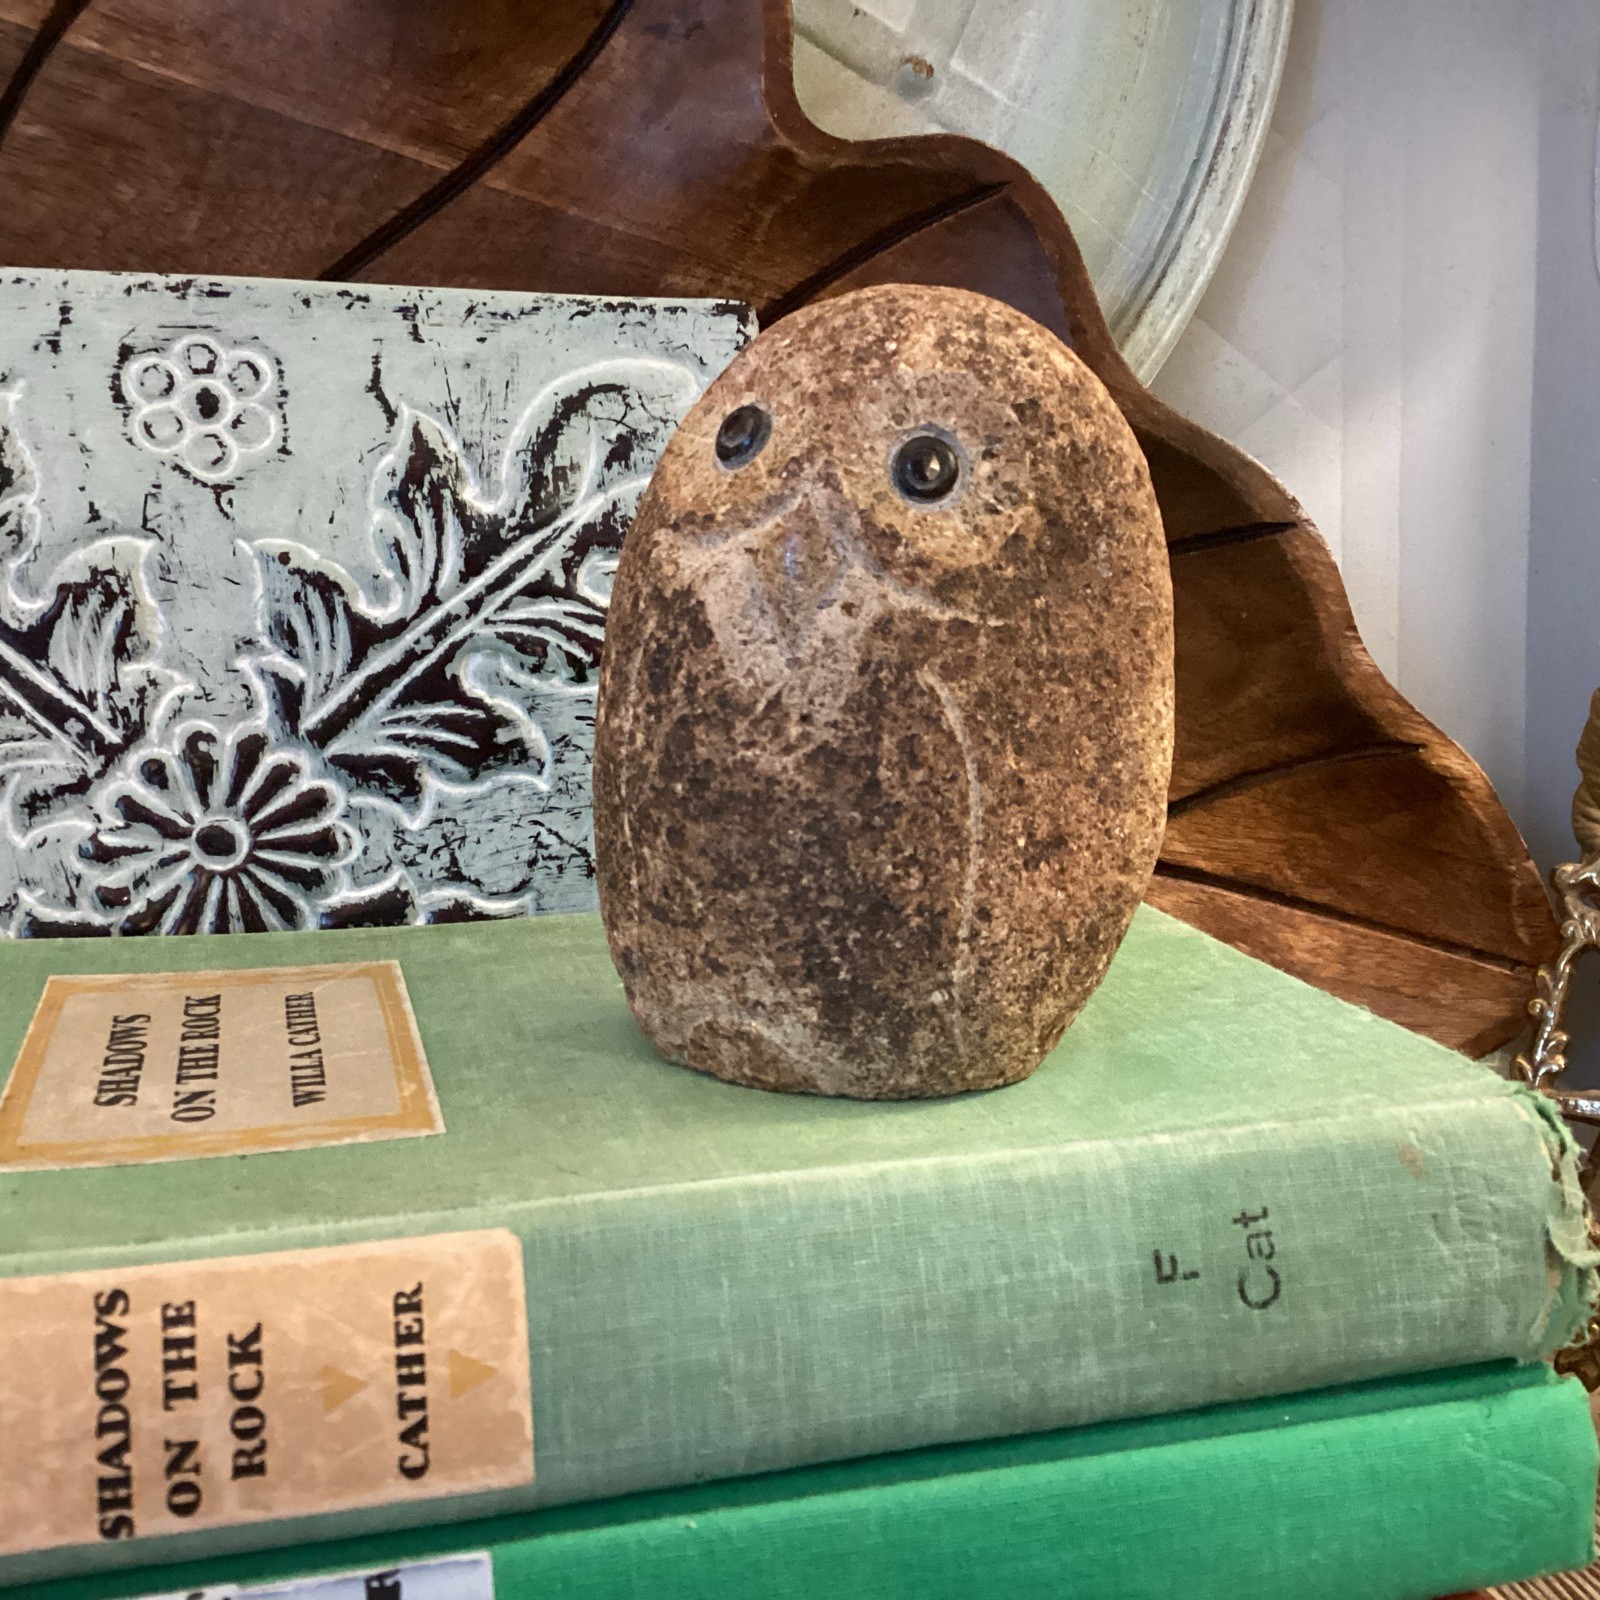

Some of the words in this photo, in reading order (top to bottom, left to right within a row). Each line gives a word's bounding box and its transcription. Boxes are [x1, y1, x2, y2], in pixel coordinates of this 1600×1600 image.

[181, 994, 221, 1041] ROCK
[285, 991, 322, 1047] CATHER
[94, 1014, 151, 1107] SHADOWS
[176, 1042, 220, 1085] THE
[290, 1048, 326, 1108] WILLA
[170, 1091, 216, 1123] ON
[1153, 1248, 1200, 1285] F
[1232, 1206, 1281, 1310] Cat
[161, 1300, 199, 1411] THE
[393, 1282, 431, 1480] CATHER
[94, 1288, 134, 1540] SHADOWS
[228, 1322, 267, 1481] ROCK
[165, 1438, 202, 1518] ON
